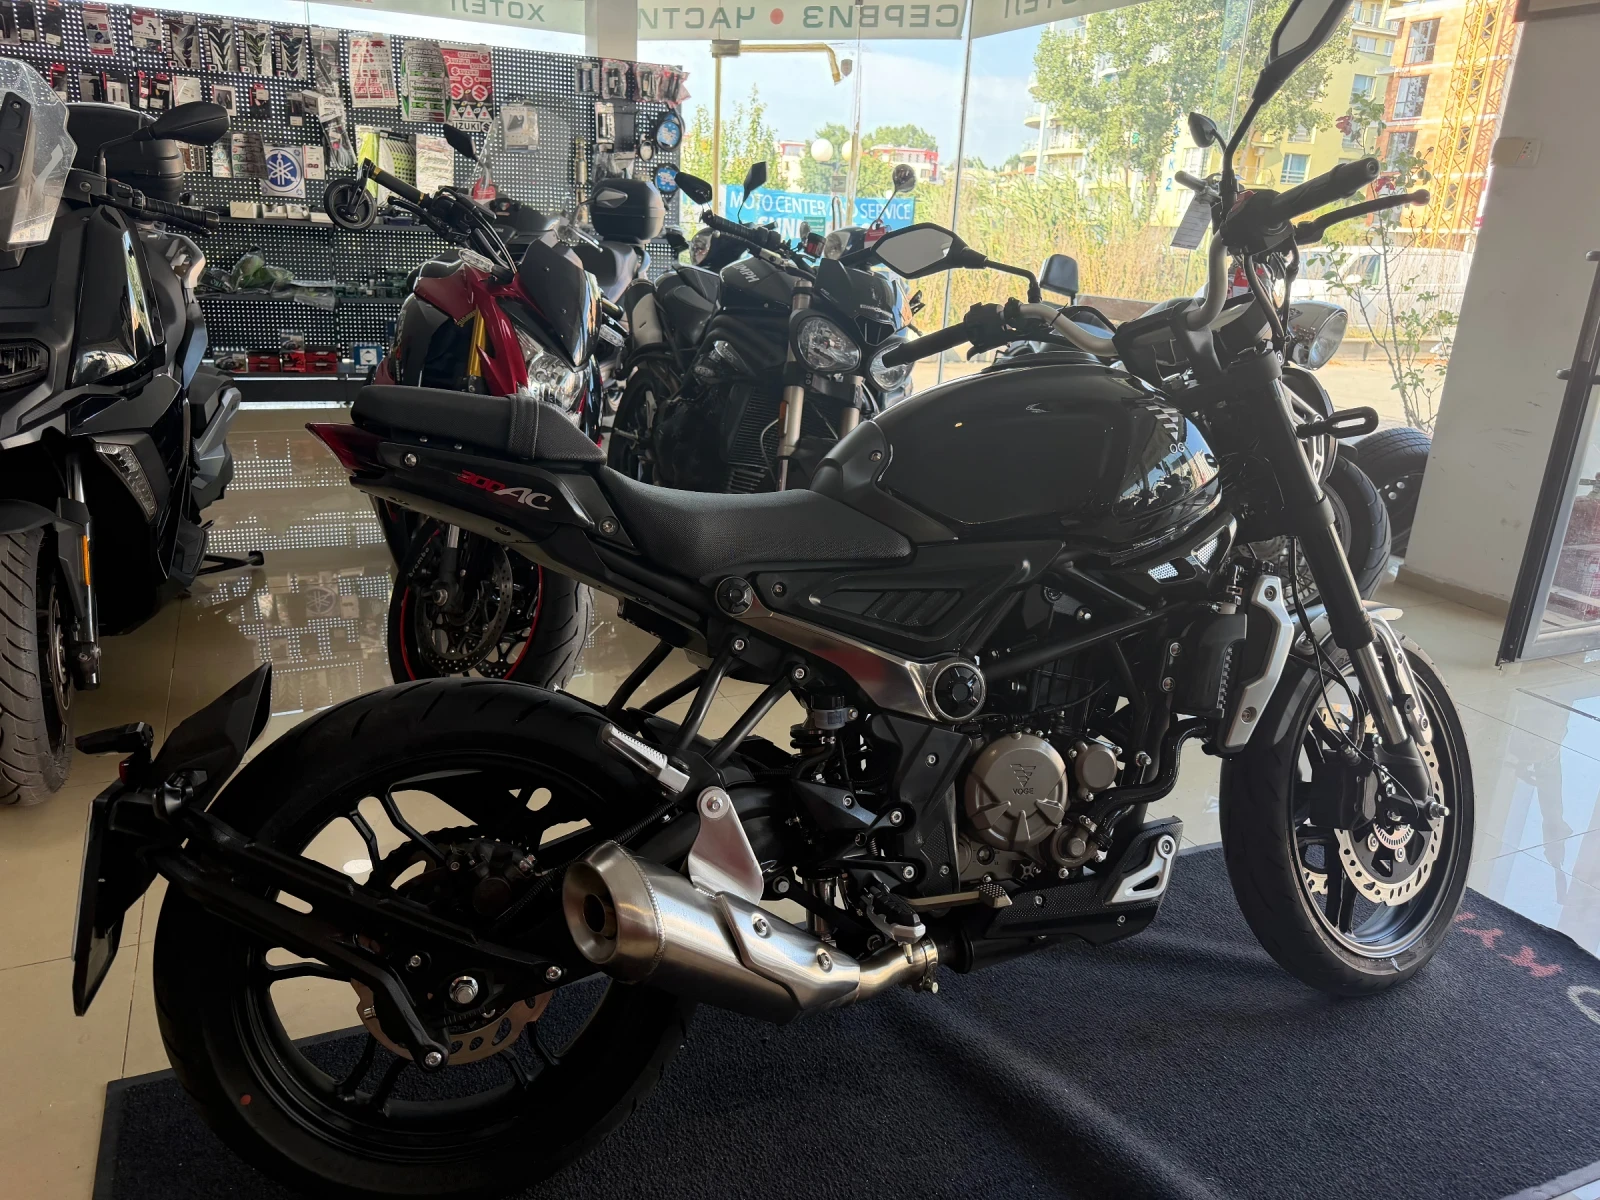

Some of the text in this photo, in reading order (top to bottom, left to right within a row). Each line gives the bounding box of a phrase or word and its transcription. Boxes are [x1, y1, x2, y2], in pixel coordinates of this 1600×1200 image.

[453, 121, 480, 131] UZUKI
[729, 191, 773, 212] MOTO
[775, 195, 826, 216] CENTER
[860, 202, 911, 220] SERVICE
[1012, 787, 1034, 795] VOGE
